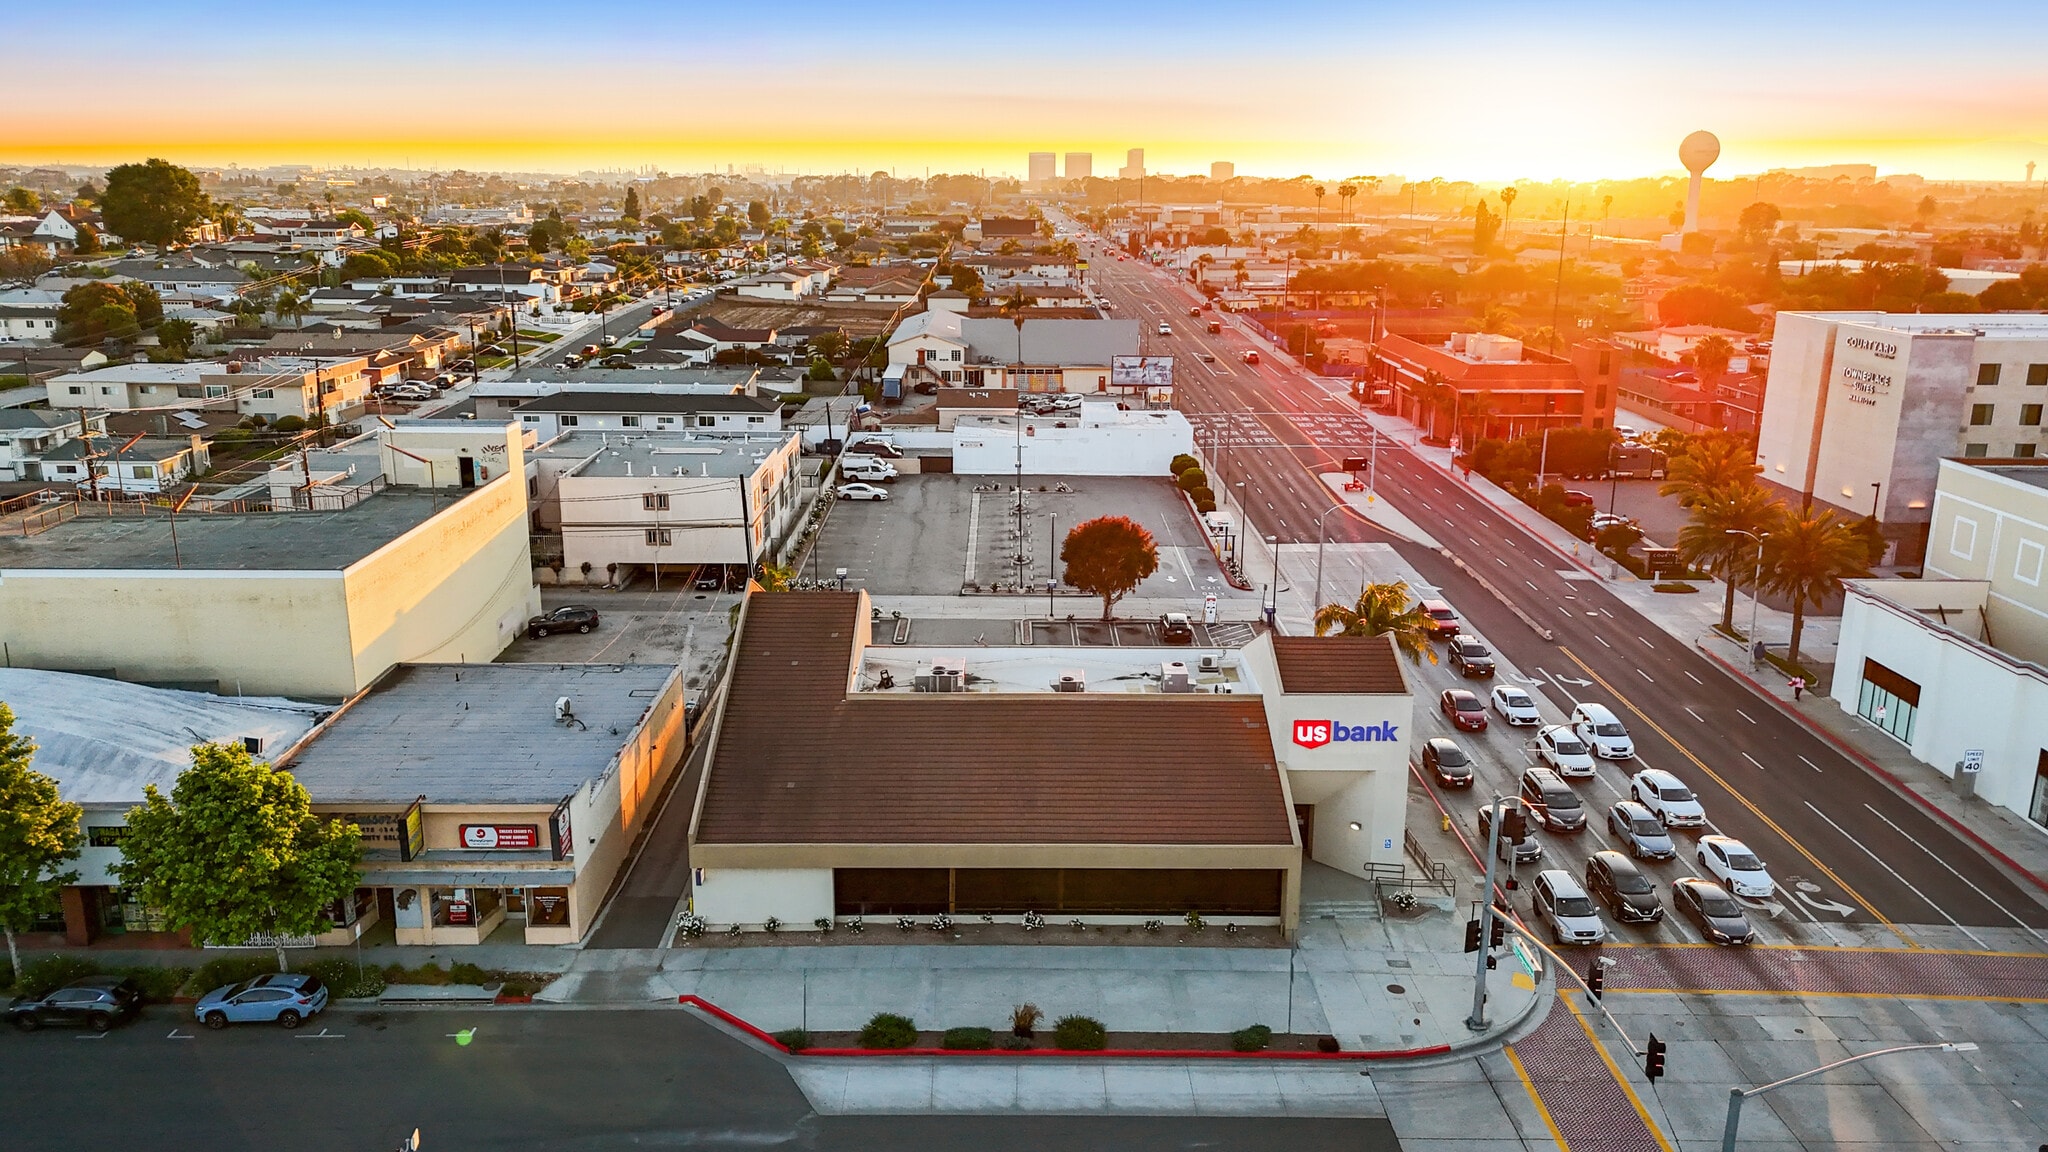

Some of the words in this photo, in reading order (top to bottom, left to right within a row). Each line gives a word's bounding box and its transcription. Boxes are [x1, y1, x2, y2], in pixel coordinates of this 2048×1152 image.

[1846, 337, 1896, 354] COURTYARD
[1843, 367, 1891, 387] TOWNEPLACE
[1852, 381, 1875, 394] SUITES
[1297, 725, 1327, 742] us
[1333, 720, 1399, 742] bank
[1965, 762, 1980, 770] 40
